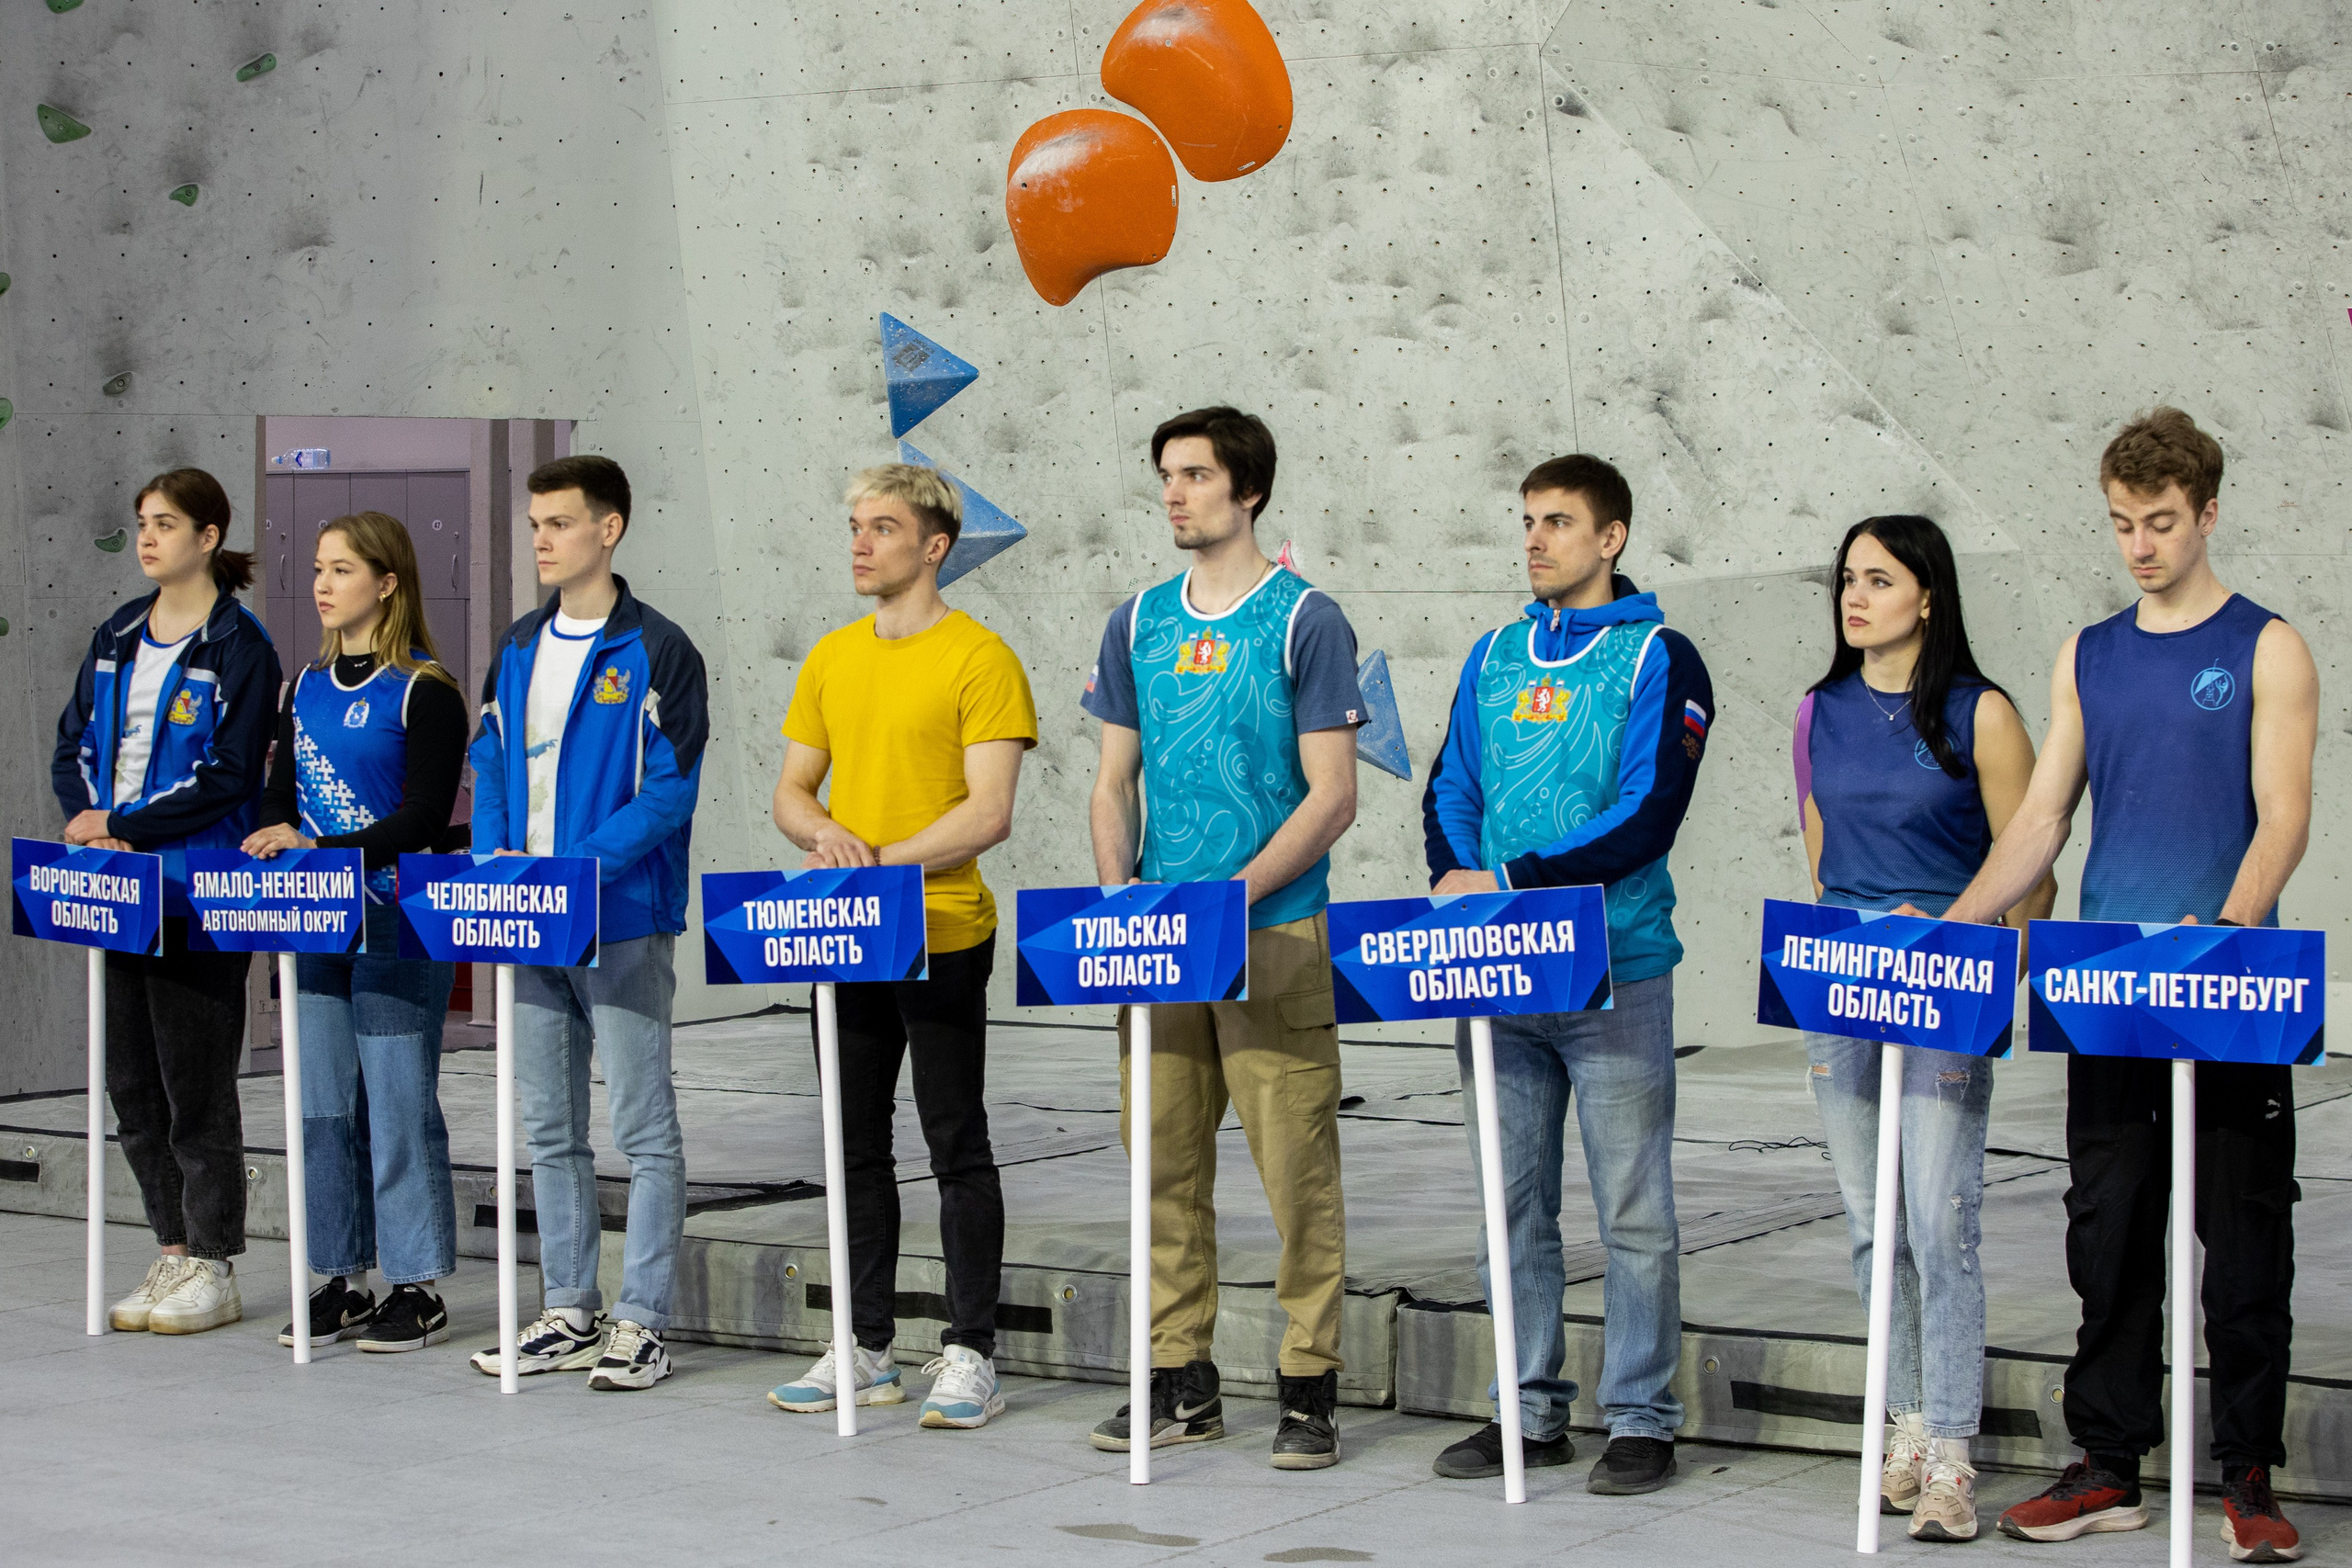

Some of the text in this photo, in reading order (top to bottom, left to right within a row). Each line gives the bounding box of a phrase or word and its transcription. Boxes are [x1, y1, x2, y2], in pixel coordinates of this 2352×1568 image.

[30, 864, 140, 905] ВОРОНЕЖСКАЯ
[193, 866, 355, 902] ЯМАЛО-НЕНЕЦКИЙ
[426, 881, 568, 914] ЧЕЛЯБИНСКАЯ
[51, 899, 119, 934] ОБЛАСТЬ
[202, 906, 348, 933] АВТОНОМНЫЙ ОКРУГ
[742, 896, 881, 931] ТЮМЕНСКАЯ
[452, 917, 540, 949] ОБЛАСТЬ
[1071, 913, 1187, 950] ТУЛЬСКАЯ
[1360, 919, 1576, 965] СВЕРДЛОВСКАЯ
[763, 934, 863, 967] ОБЛАСТЬ
[1781, 934, 1994, 995] ЛЕНИНГРАДСКАЯ
[1078, 953, 1181, 988] ОБЛАСТЬ
[1408, 963, 1532, 1002] ОБЛАСТЬ
[1827, 982, 1940, 1030] ОБЛАСТЬ
[2045, 967, 2310, 1013] САНКТ-ПЕТЕРБУРГ
[1289, 1410, 1309, 1422] NIKE
